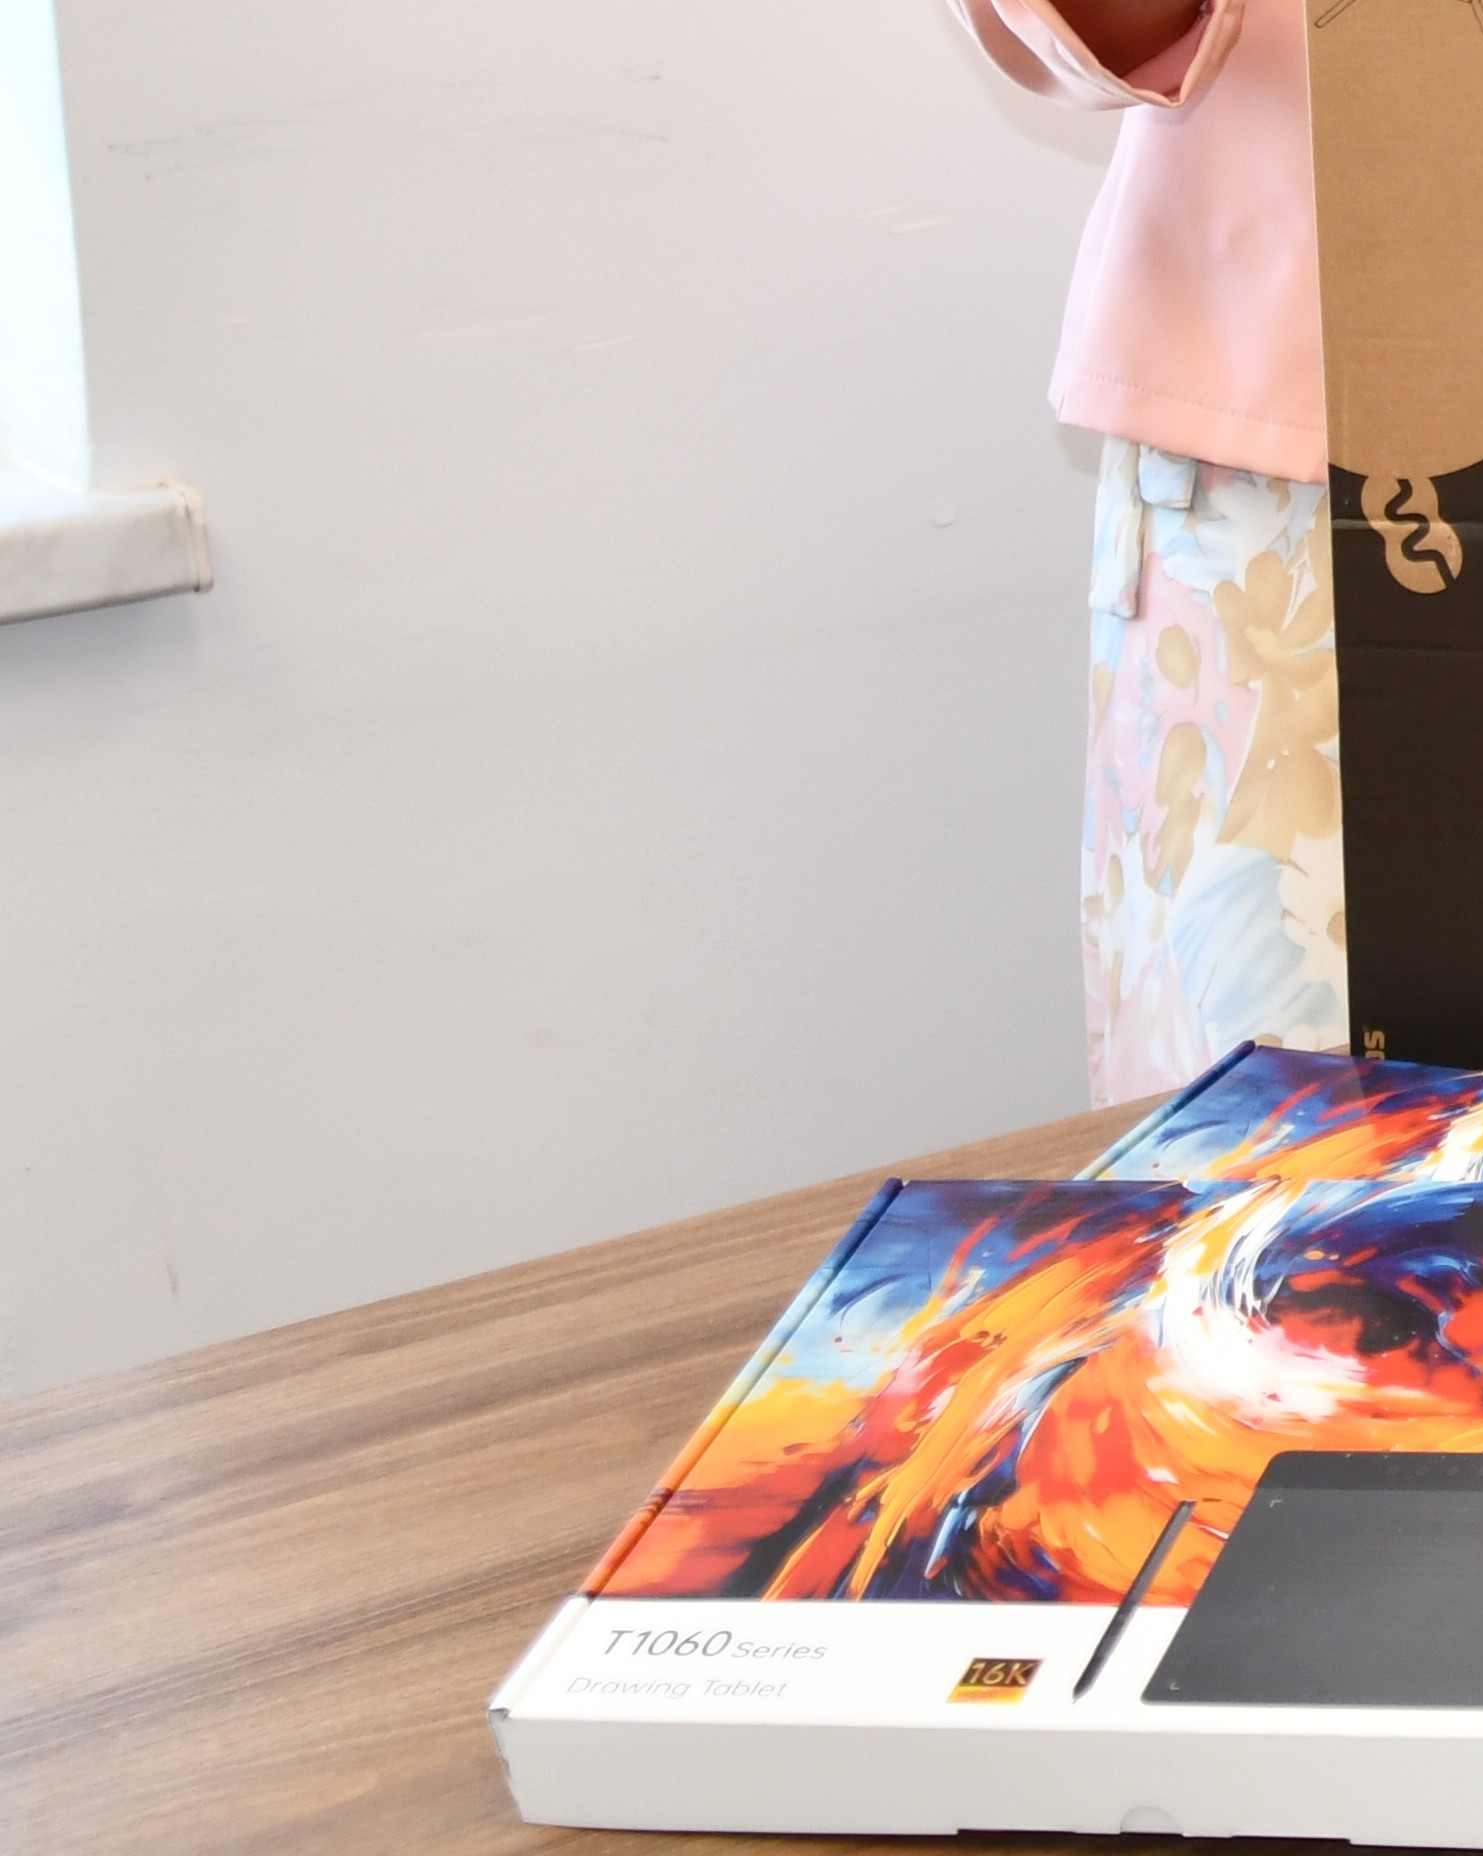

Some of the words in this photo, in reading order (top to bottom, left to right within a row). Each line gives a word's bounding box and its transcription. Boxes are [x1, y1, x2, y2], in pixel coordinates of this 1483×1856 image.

[602, 1629, 733, 1657] T1060
[731, 1641, 828, 1660] Series
[967, 1661, 1036, 1686] 16K
[565, 1676, 692, 1700] Drawing
[702, 1679, 788, 1698] Tablet
